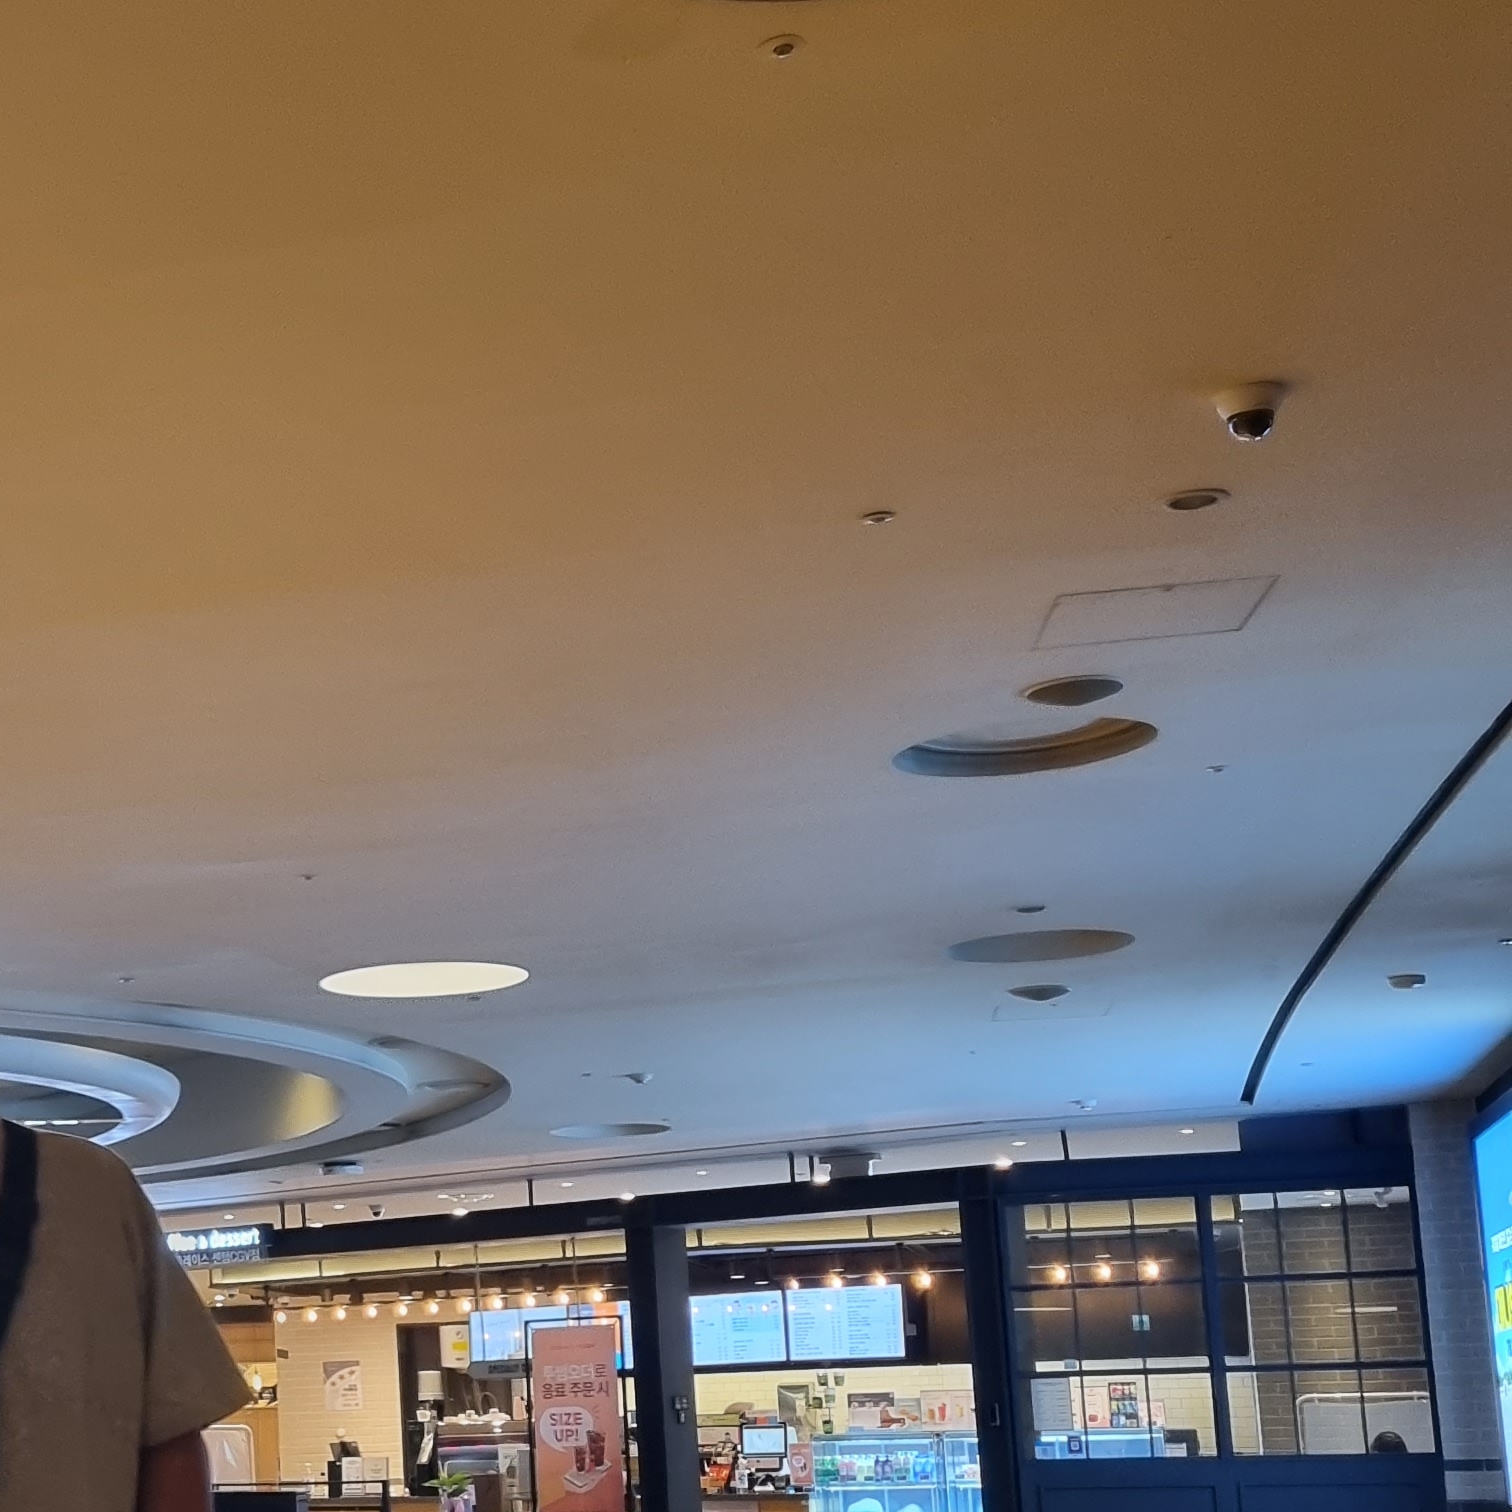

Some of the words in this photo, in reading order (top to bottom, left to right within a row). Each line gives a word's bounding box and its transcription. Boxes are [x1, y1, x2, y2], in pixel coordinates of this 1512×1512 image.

[542, 1383, 567, 1400] 음료
[549, 1412, 583, 1426] SIZE
[553, 1428, 579, 1443] UP!
